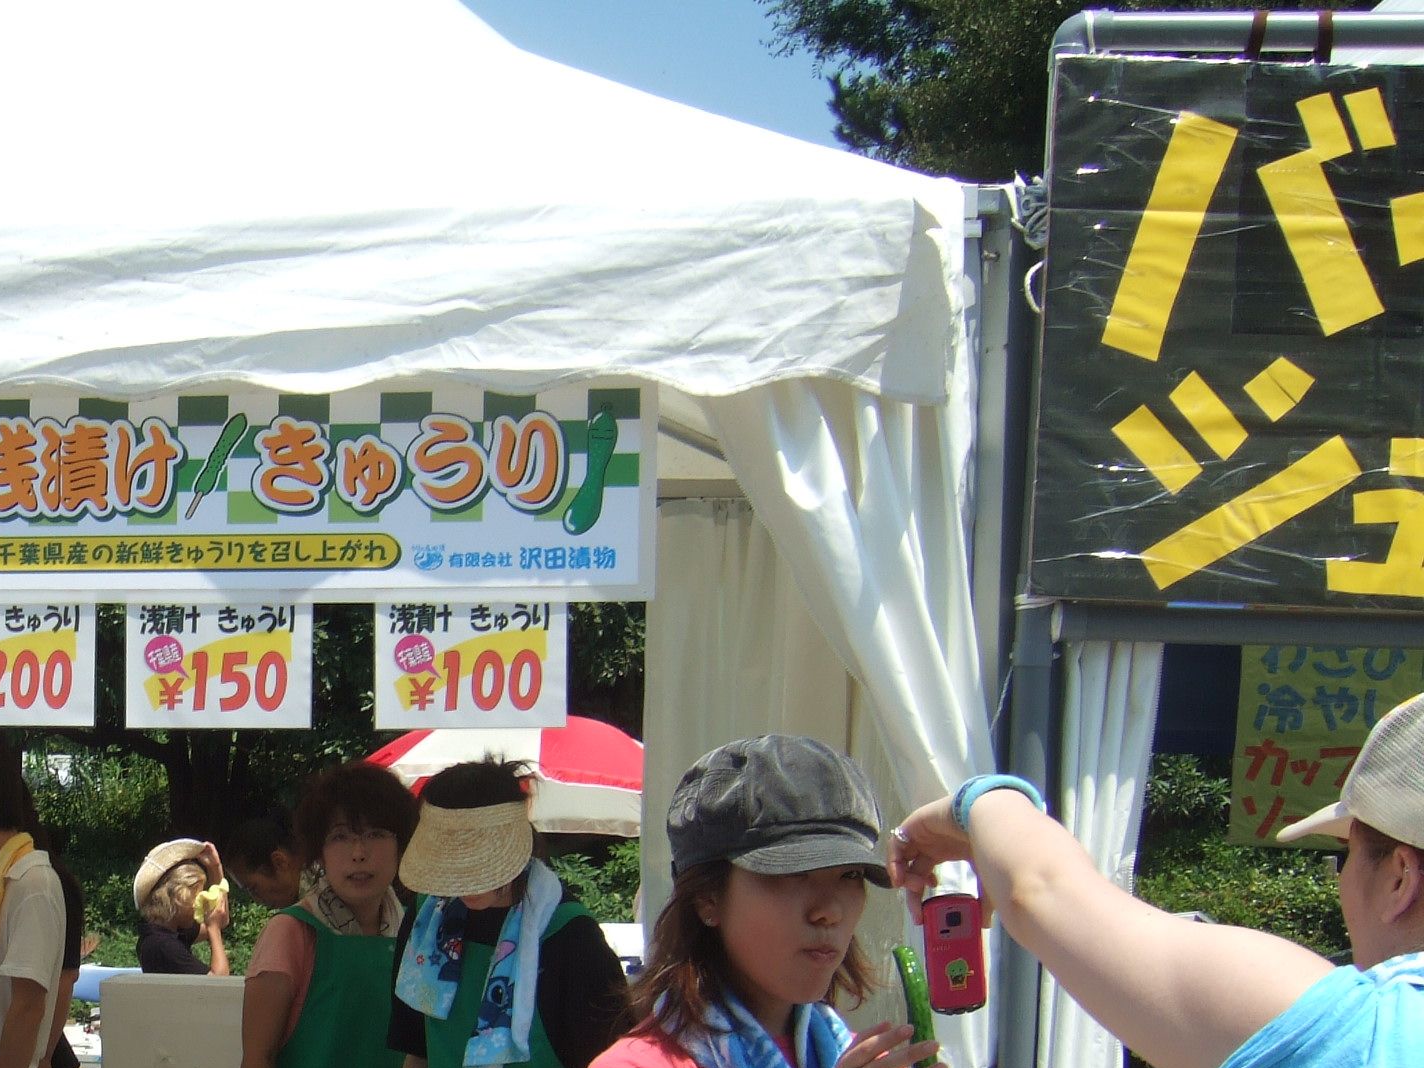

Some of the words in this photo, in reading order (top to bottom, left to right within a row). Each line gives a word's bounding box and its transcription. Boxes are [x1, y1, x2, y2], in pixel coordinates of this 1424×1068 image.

[257, 416, 560, 508] きゅうり
[449, 552, 513, 568] 有限会社
[519, 547, 616, 570] 沢田漬物
[5, 605, 80, 633] きゅうり
[218, 605, 295, 633] きゅうり
[470, 602, 550, 632] きゅうり
